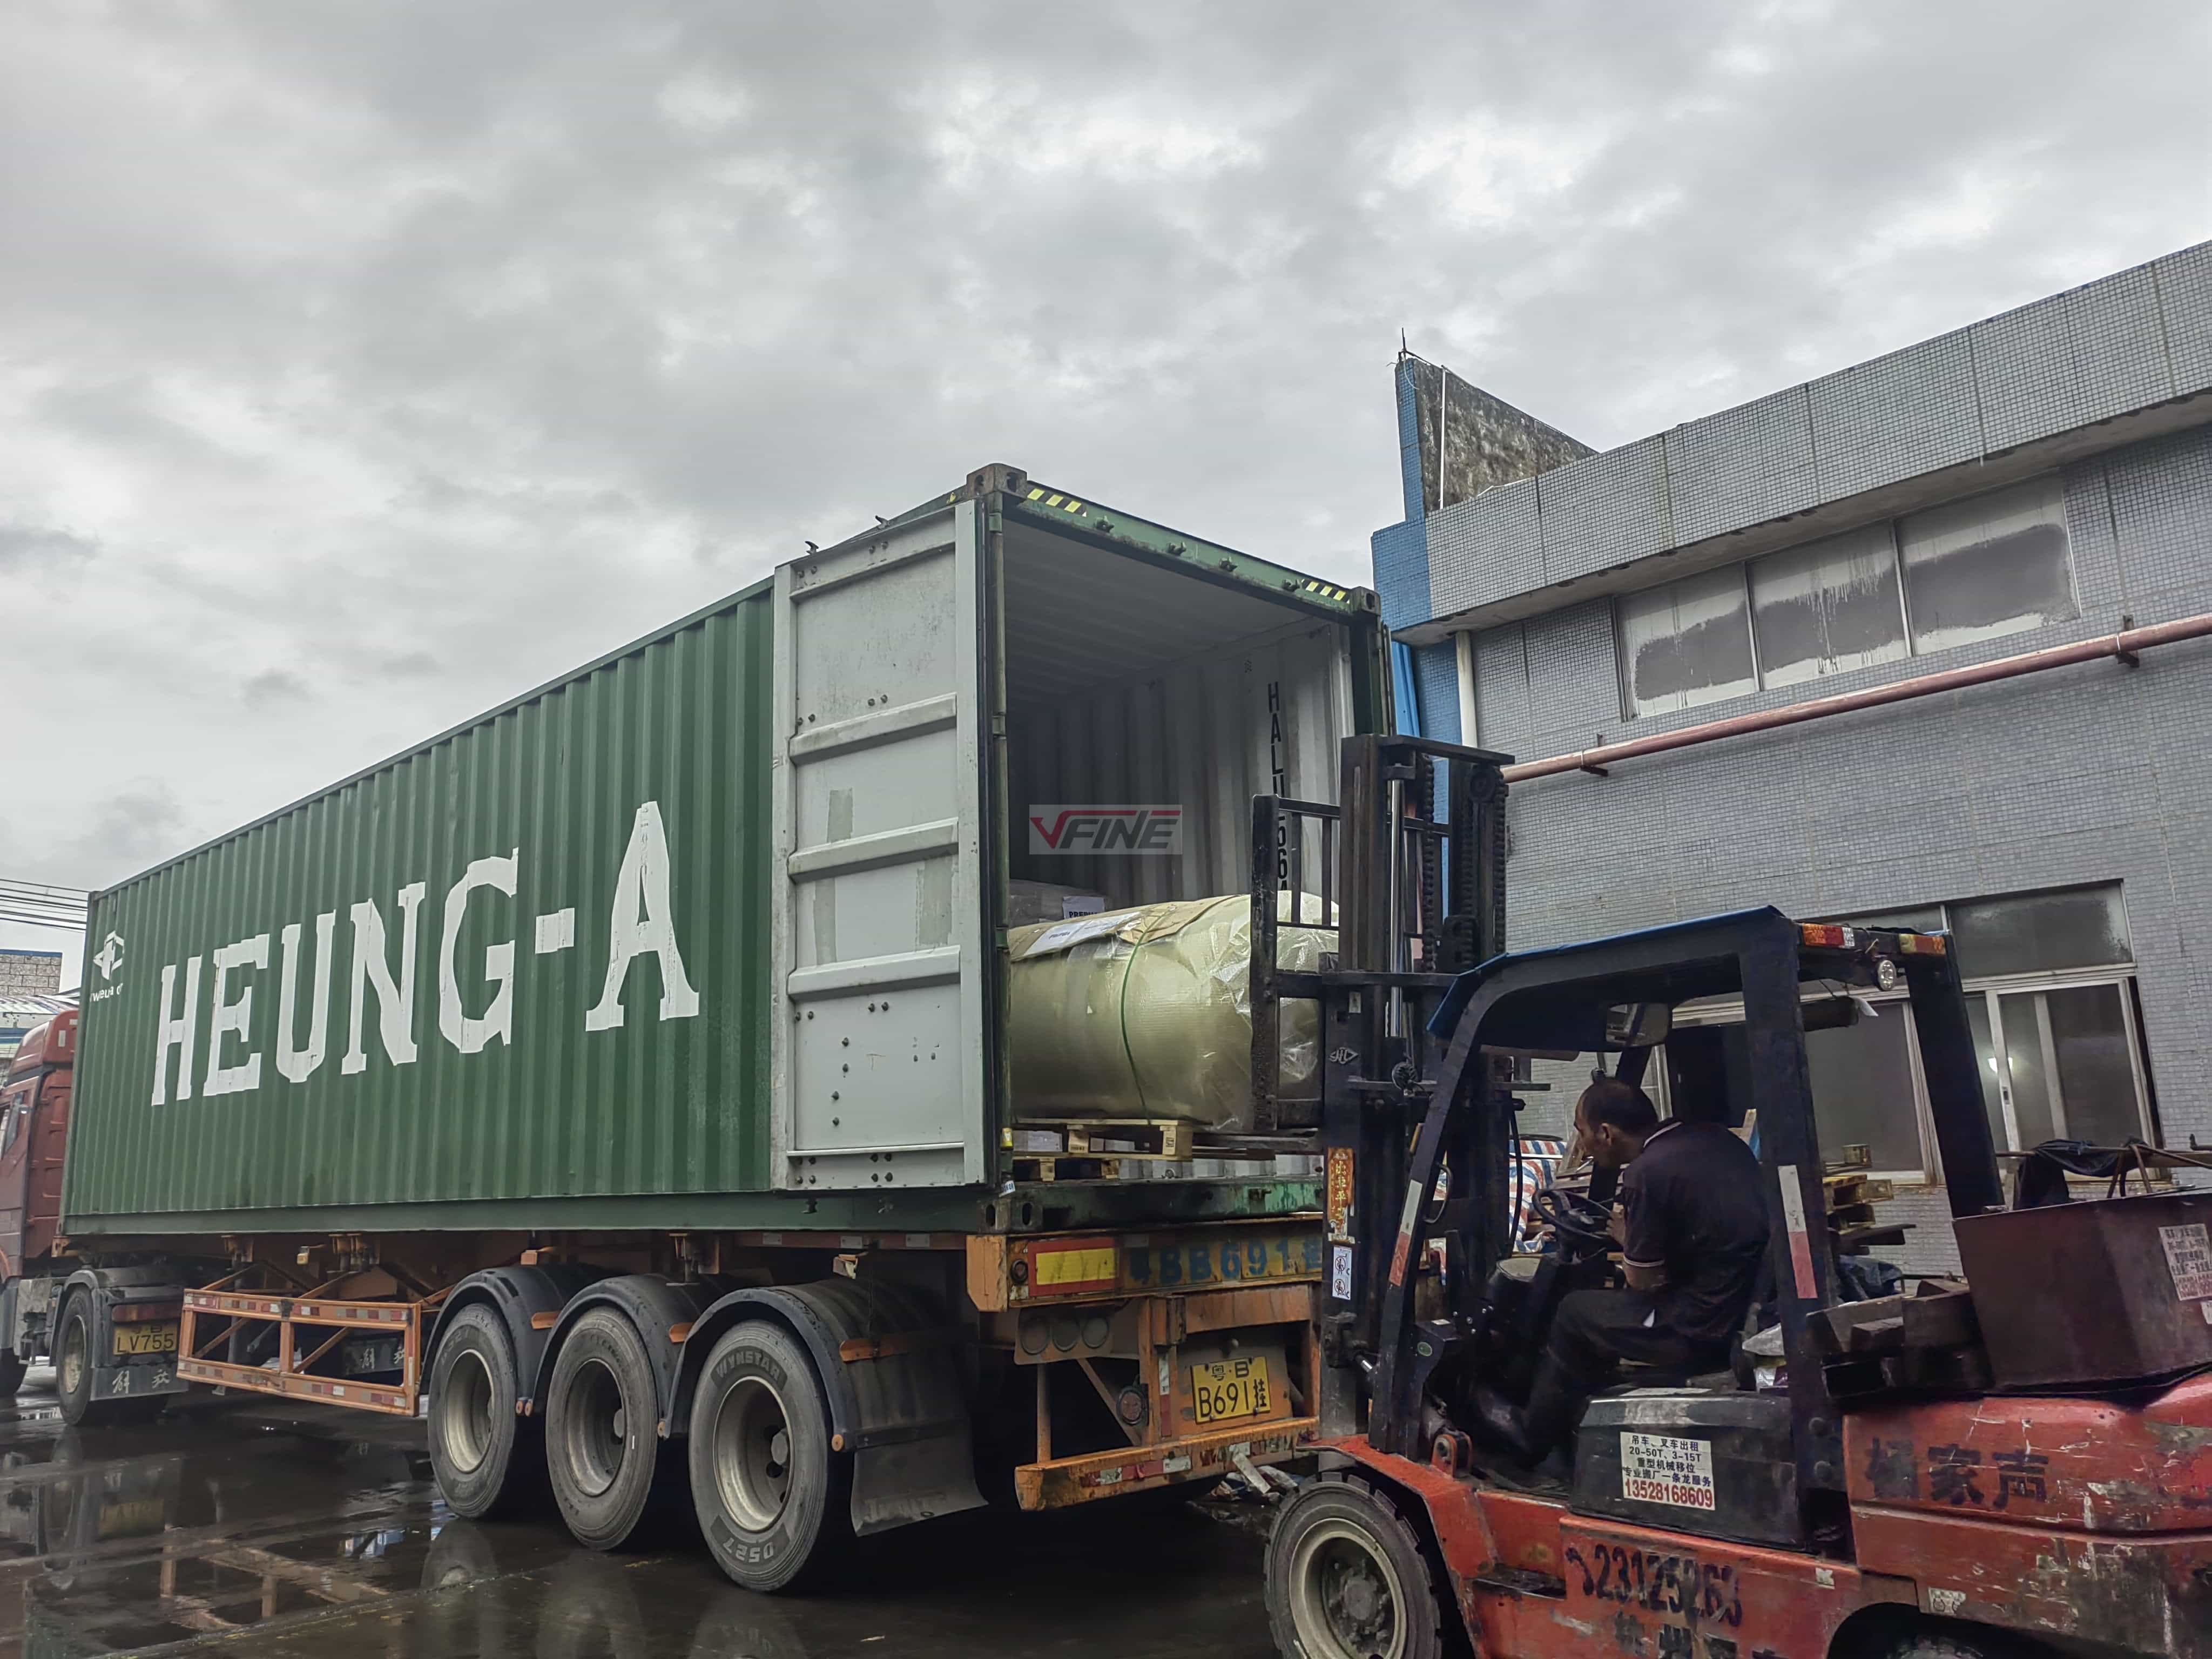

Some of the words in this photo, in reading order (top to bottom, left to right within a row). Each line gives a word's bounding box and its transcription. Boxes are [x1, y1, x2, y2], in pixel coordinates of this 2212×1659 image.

[152, 801, 700, 1106] HEUNG-A
[117, 1333, 174, 1353] LV755
[1198, 1378, 1267, 1418] B691挂
[1622, 1466, 1711, 1487] 专业搬厂一条龙服务
[1637, 1457, 1696, 1474] 重型机械移位
[1625, 1478, 1713, 1508] 13528168609
